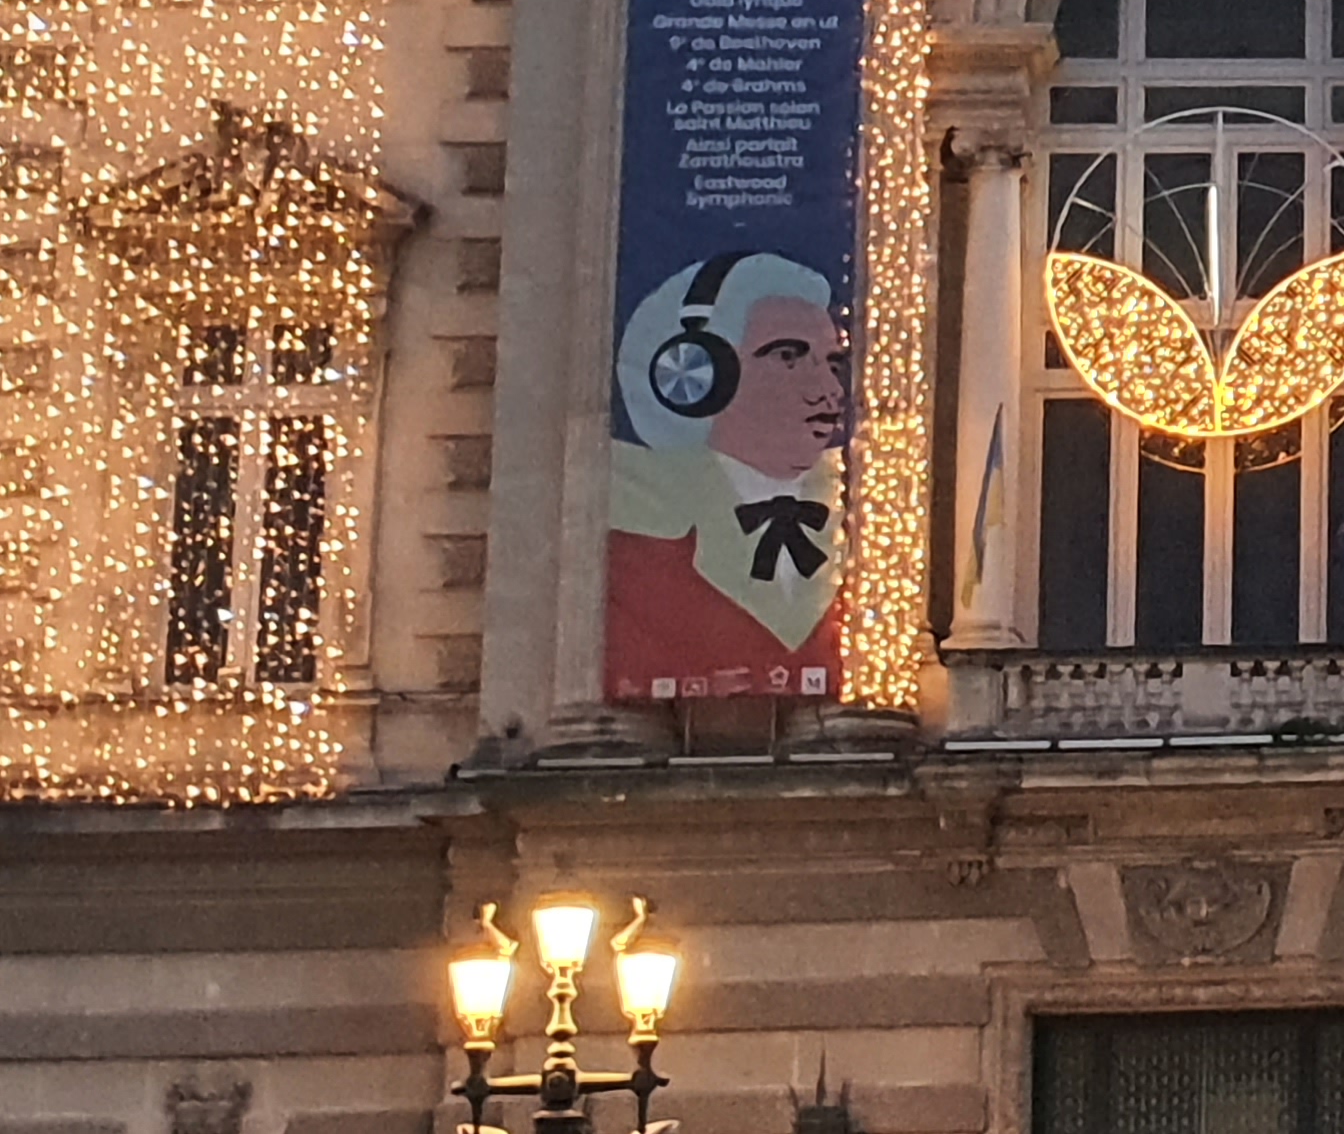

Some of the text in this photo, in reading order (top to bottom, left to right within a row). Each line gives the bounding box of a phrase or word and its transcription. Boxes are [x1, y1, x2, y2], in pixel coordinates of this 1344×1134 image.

[652, 14, 724, 29] Grande
[719, 35, 821, 50] Beethoven
[708, 57, 732, 71] de
[737, 56, 803, 71] Mahler
[732, 77, 806, 93] Brahms
[691, 100, 765, 114] Passion
[725, 116, 812, 131] Matthieu
[678, 153, 804, 168] Zarathoustra
[694, 174, 787, 190] Eastwood
